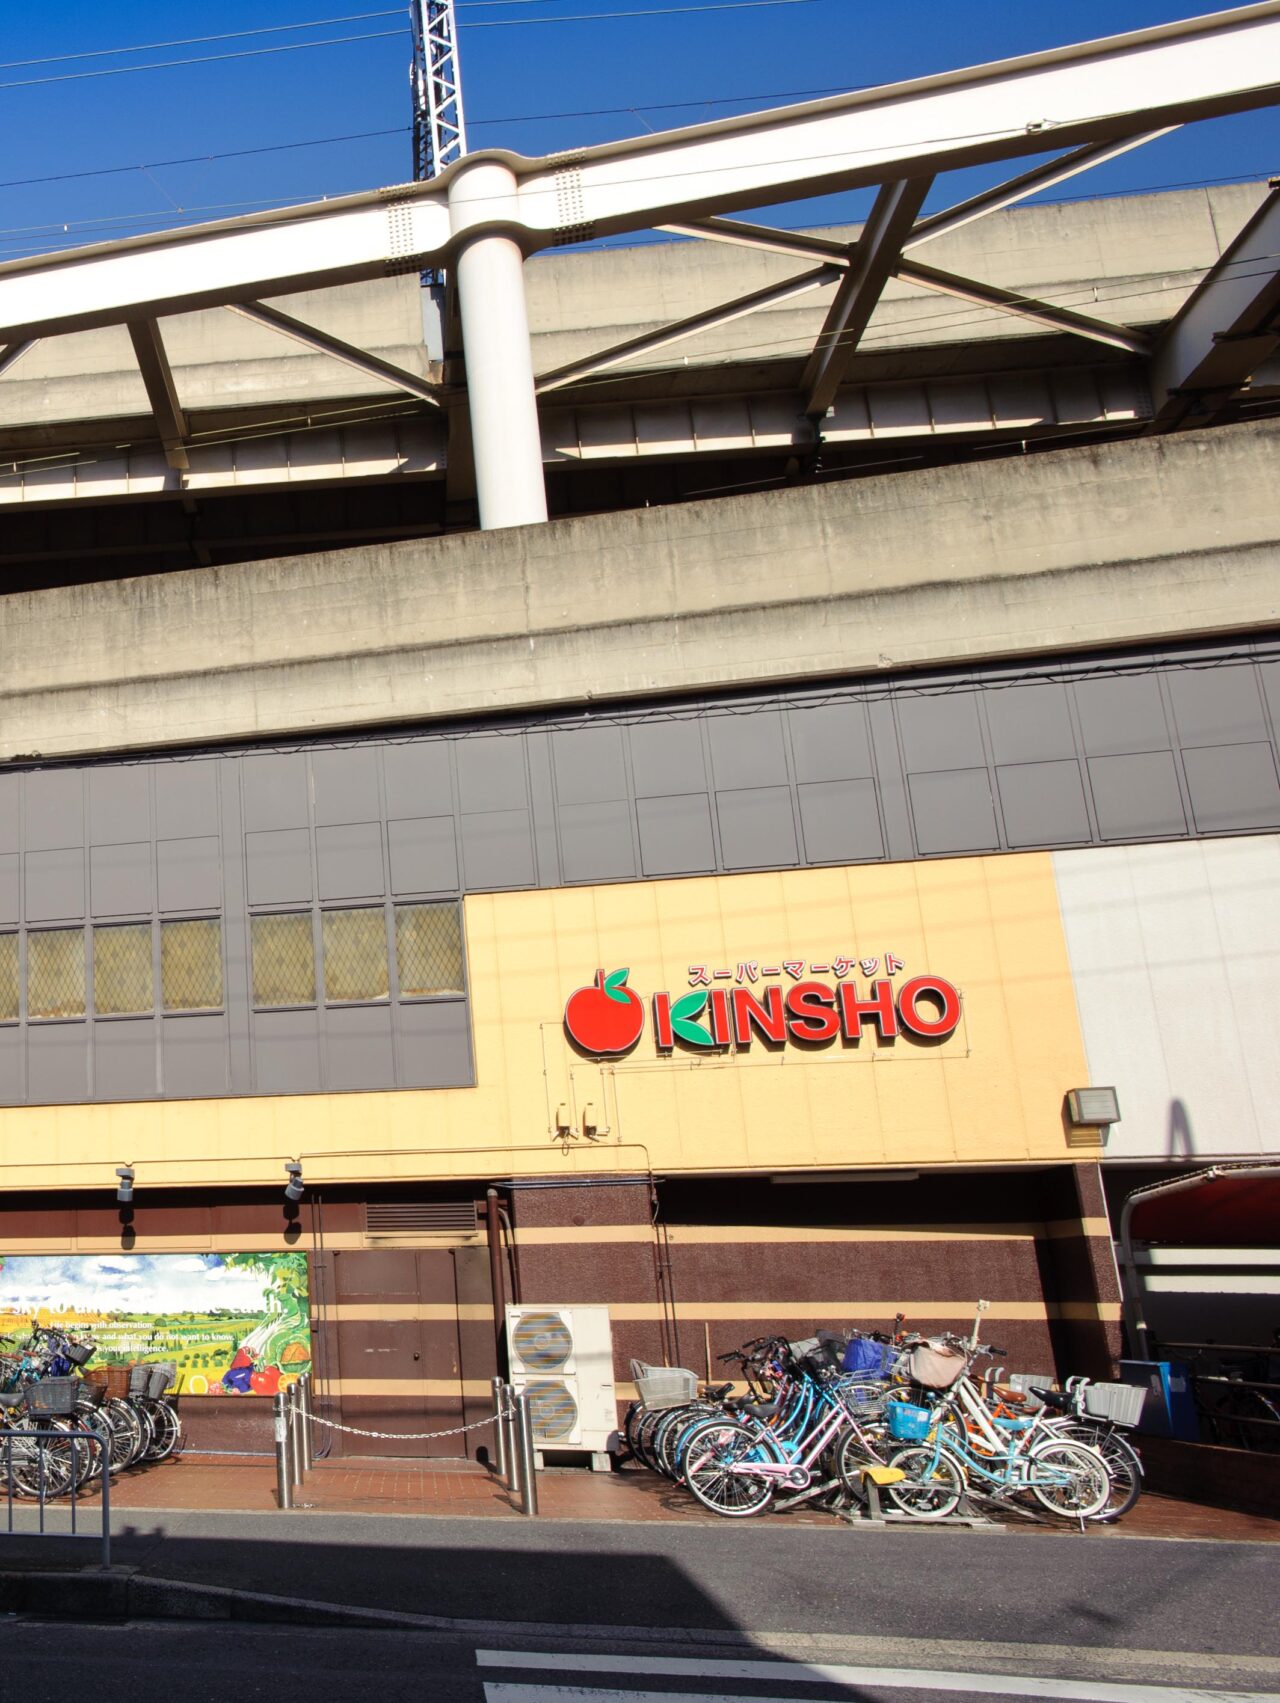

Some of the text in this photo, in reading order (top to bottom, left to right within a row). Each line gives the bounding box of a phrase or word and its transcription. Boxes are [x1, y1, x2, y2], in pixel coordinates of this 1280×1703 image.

[688, 952, 906, 985] スーパーマーケット
[651, 974, 962, 1048] KINSHO
